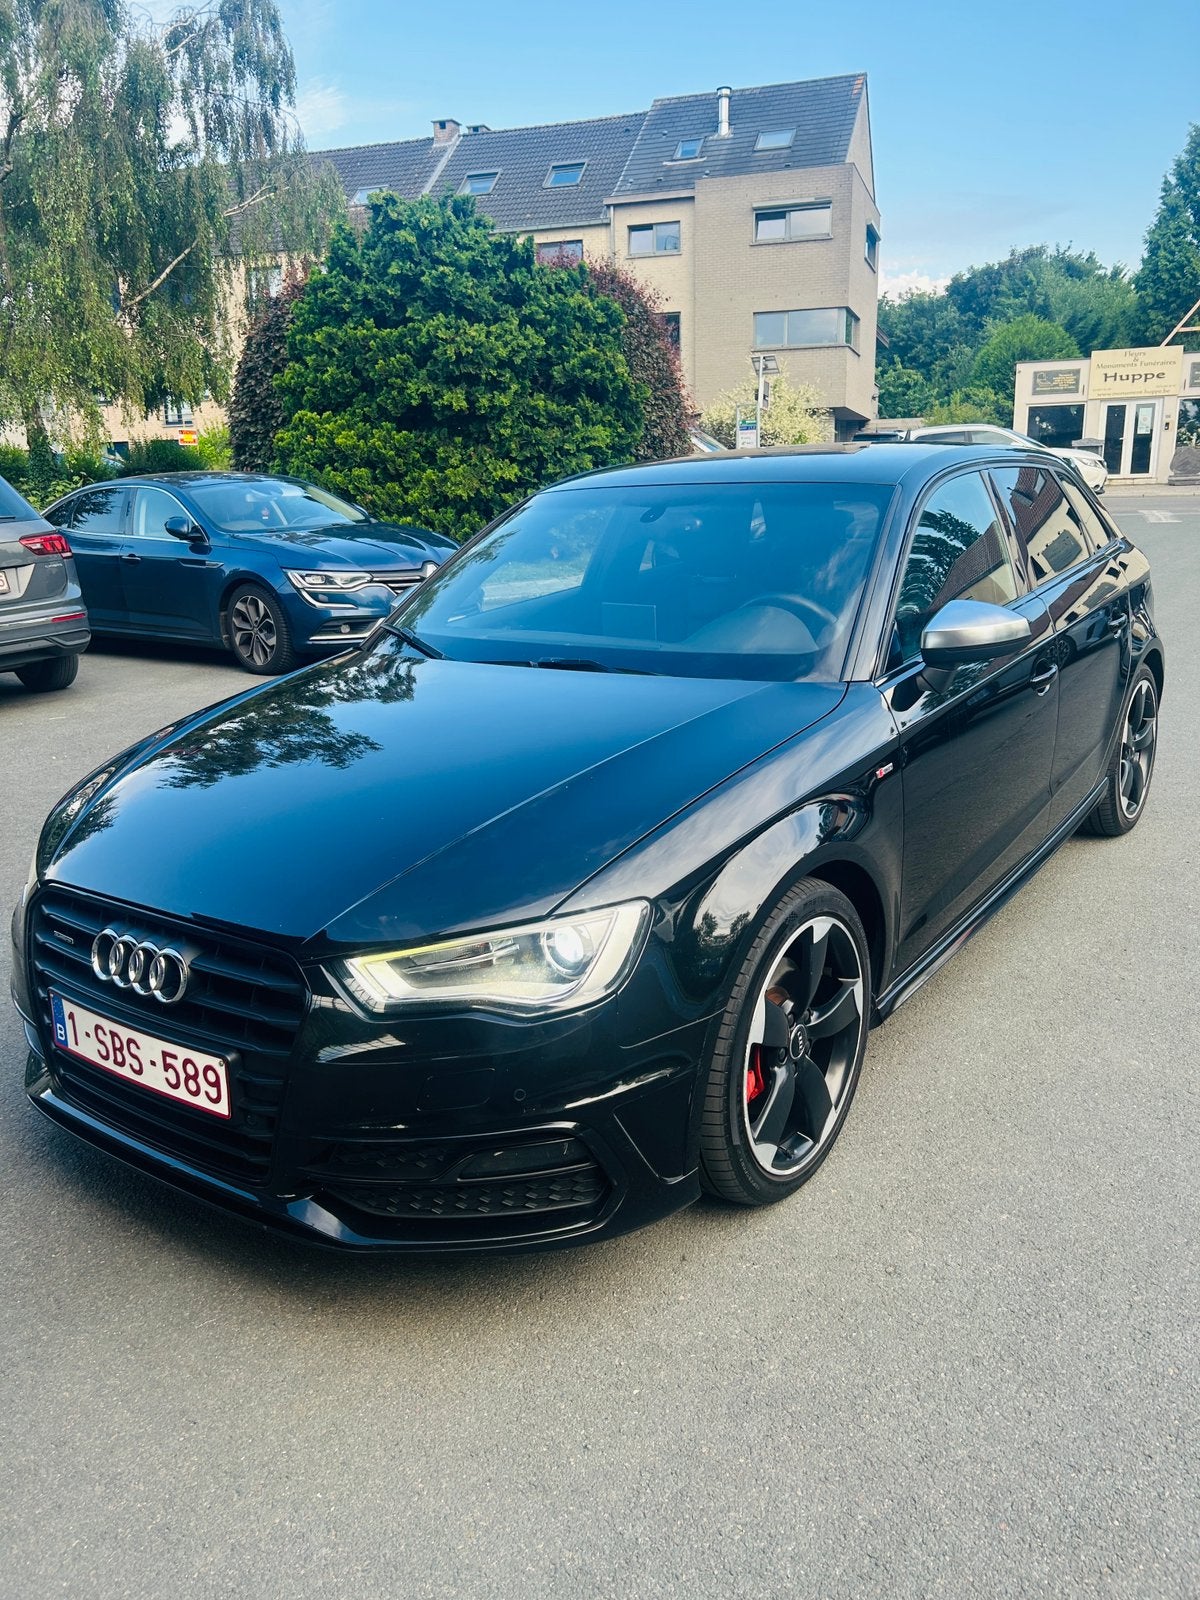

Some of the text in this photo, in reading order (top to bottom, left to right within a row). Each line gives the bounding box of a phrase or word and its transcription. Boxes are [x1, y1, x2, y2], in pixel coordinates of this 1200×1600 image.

[1103, 372, 1166, 383] Huppe
[56, 1023, 66, 1041] B
[67, 1011, 222, 1105] 1-SBS-589
